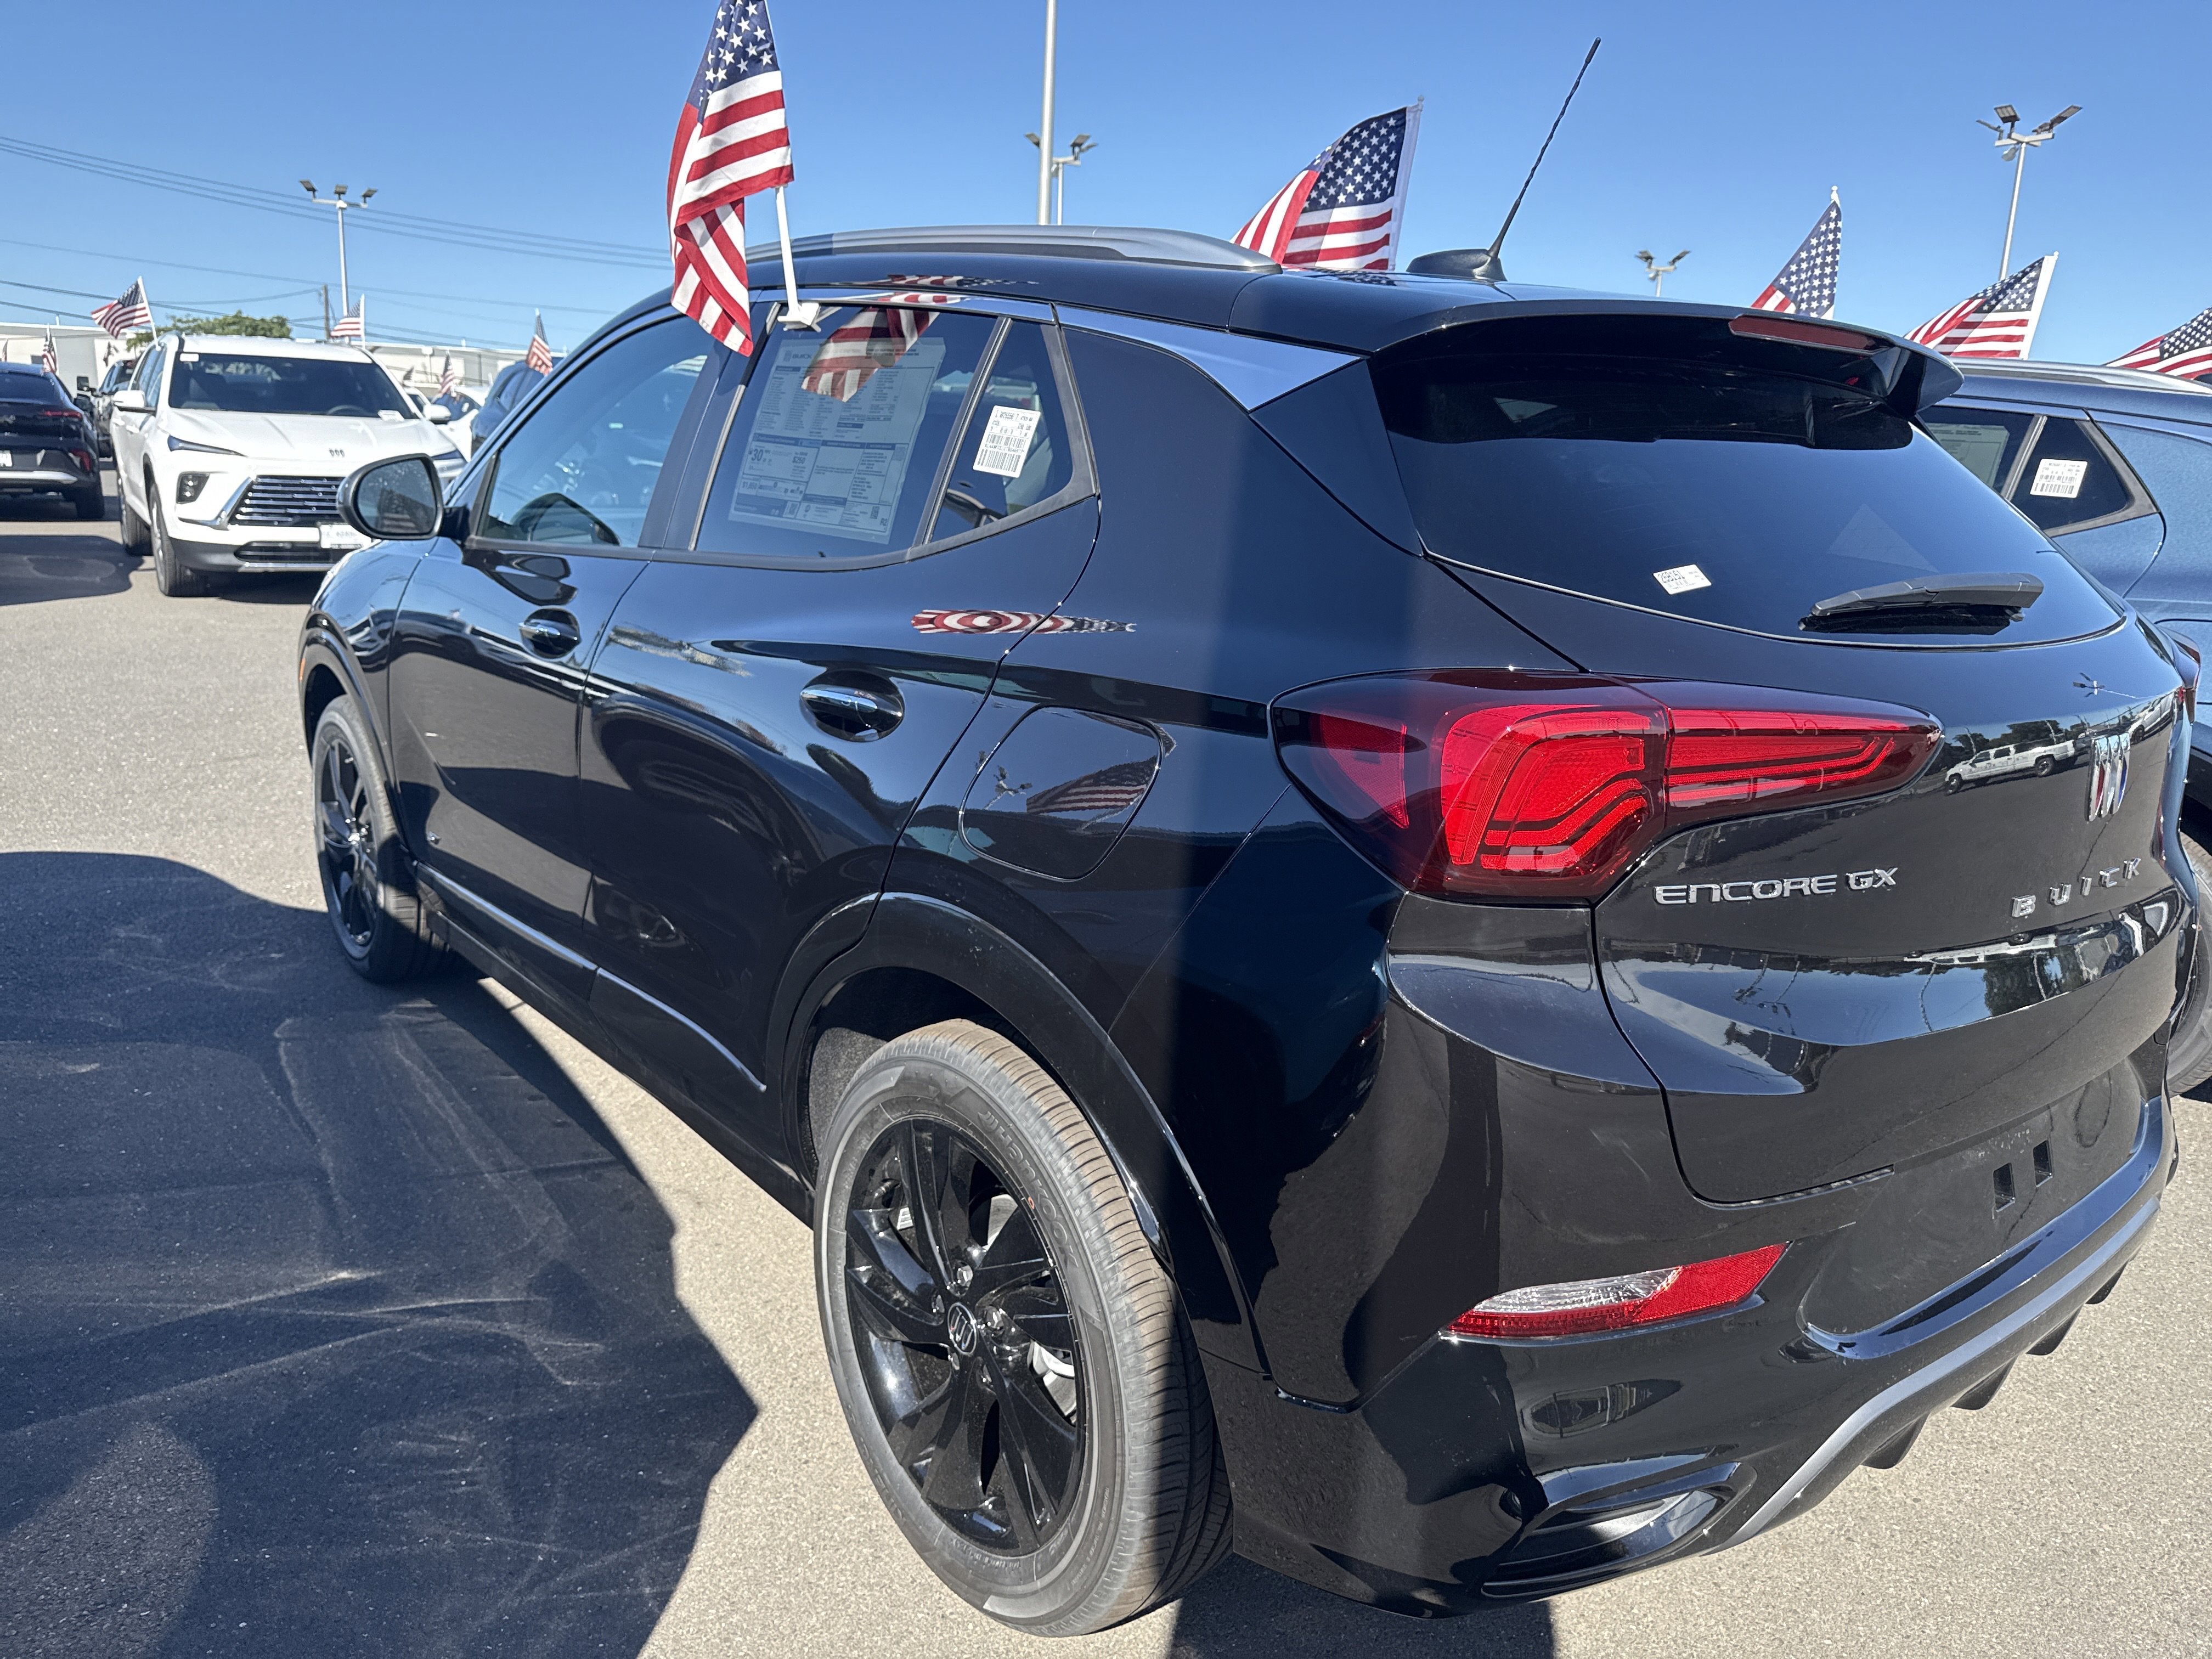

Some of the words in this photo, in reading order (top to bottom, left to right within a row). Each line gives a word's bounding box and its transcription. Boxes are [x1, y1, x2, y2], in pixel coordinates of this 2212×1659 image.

[1654, 874, 1838, 905] ENCORE
[1847, 867, 1898, 891] GX
[2012, 857, 2141, 918] BUICK
